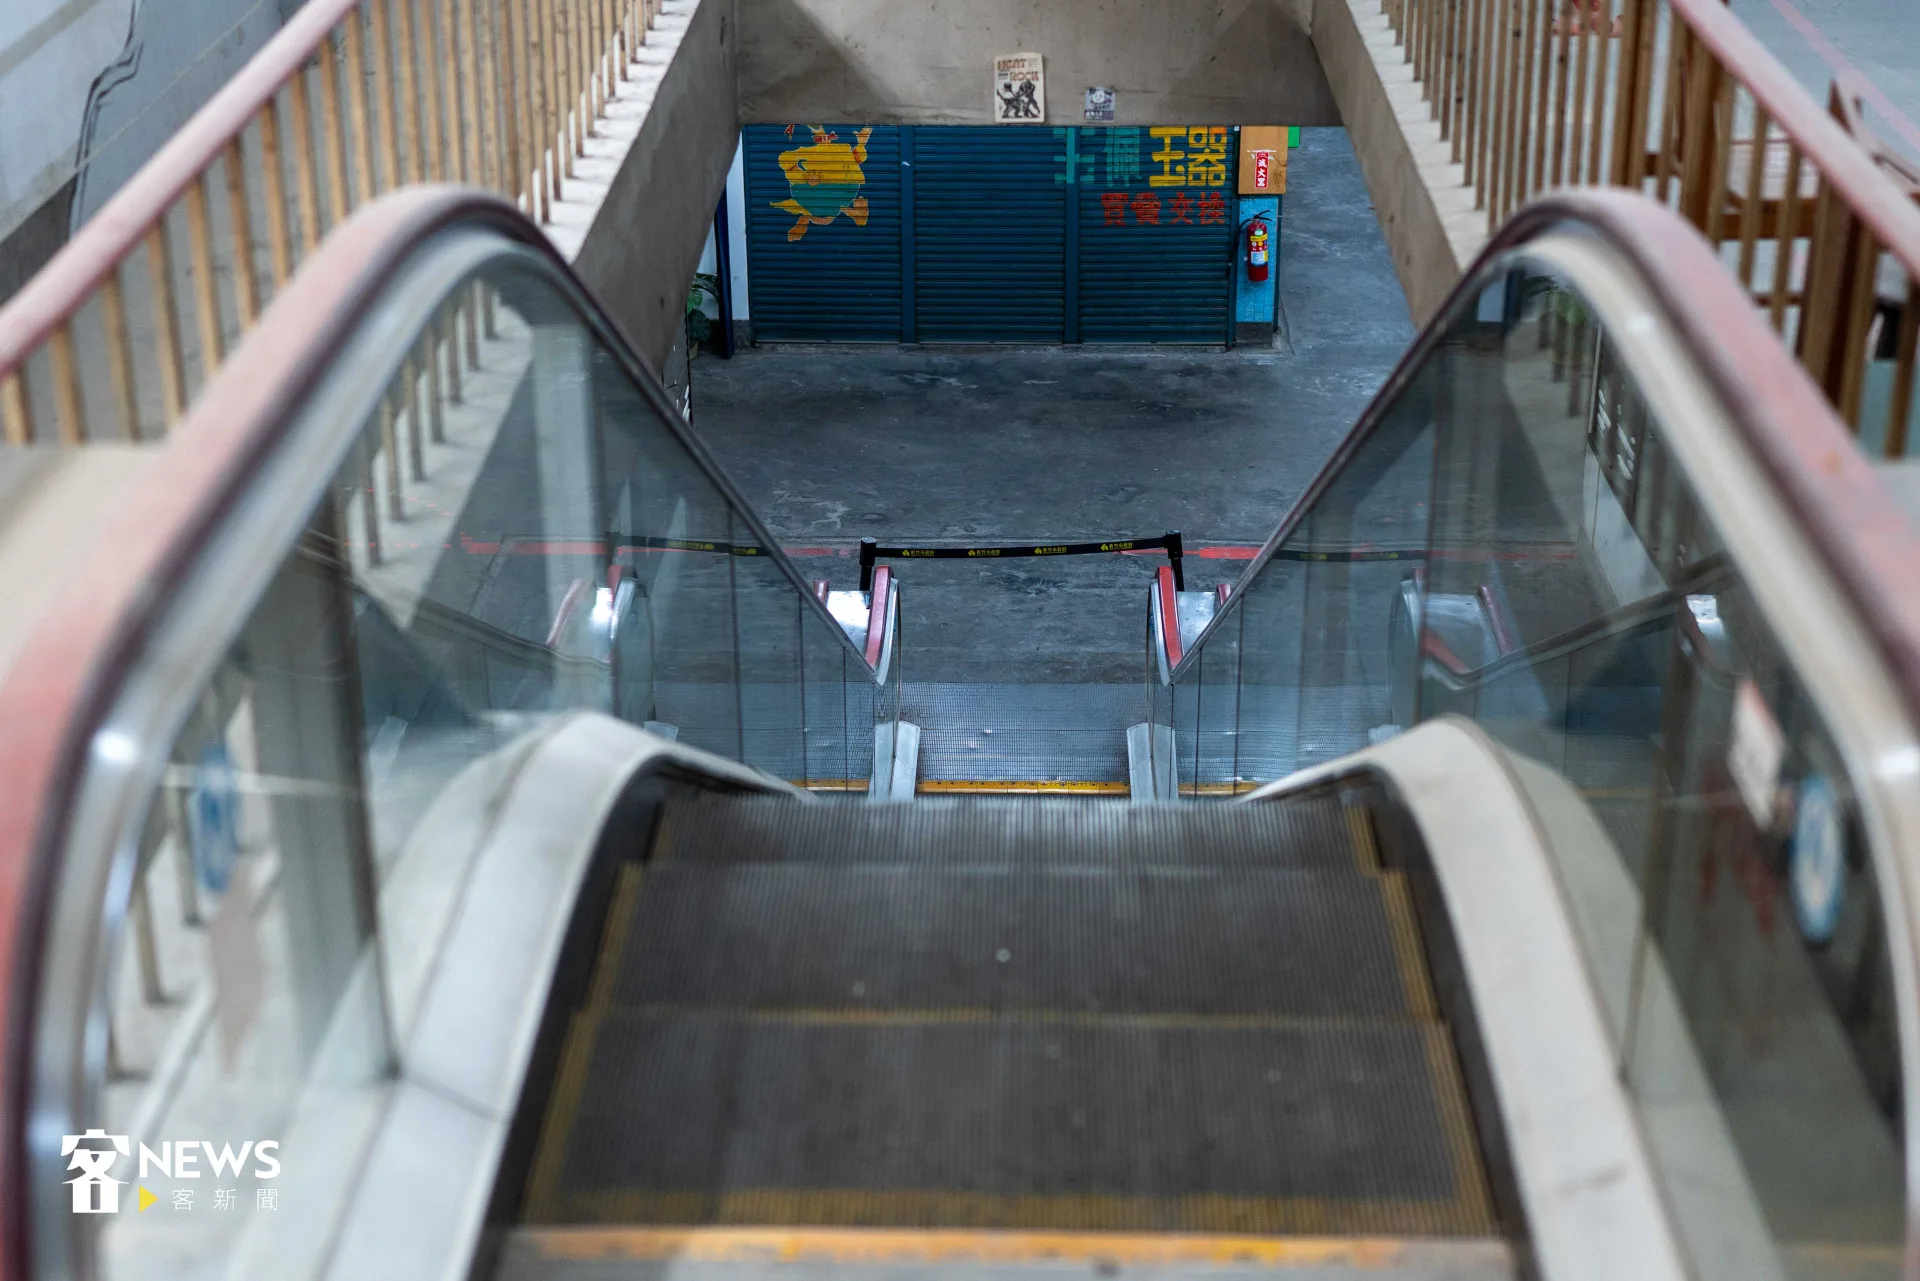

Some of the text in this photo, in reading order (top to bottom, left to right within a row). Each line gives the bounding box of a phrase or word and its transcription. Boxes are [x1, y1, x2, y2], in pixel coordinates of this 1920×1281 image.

[1149, 127, 1227, 187] 玉器
[1101, 192, 1226, 226] 買賣交換
